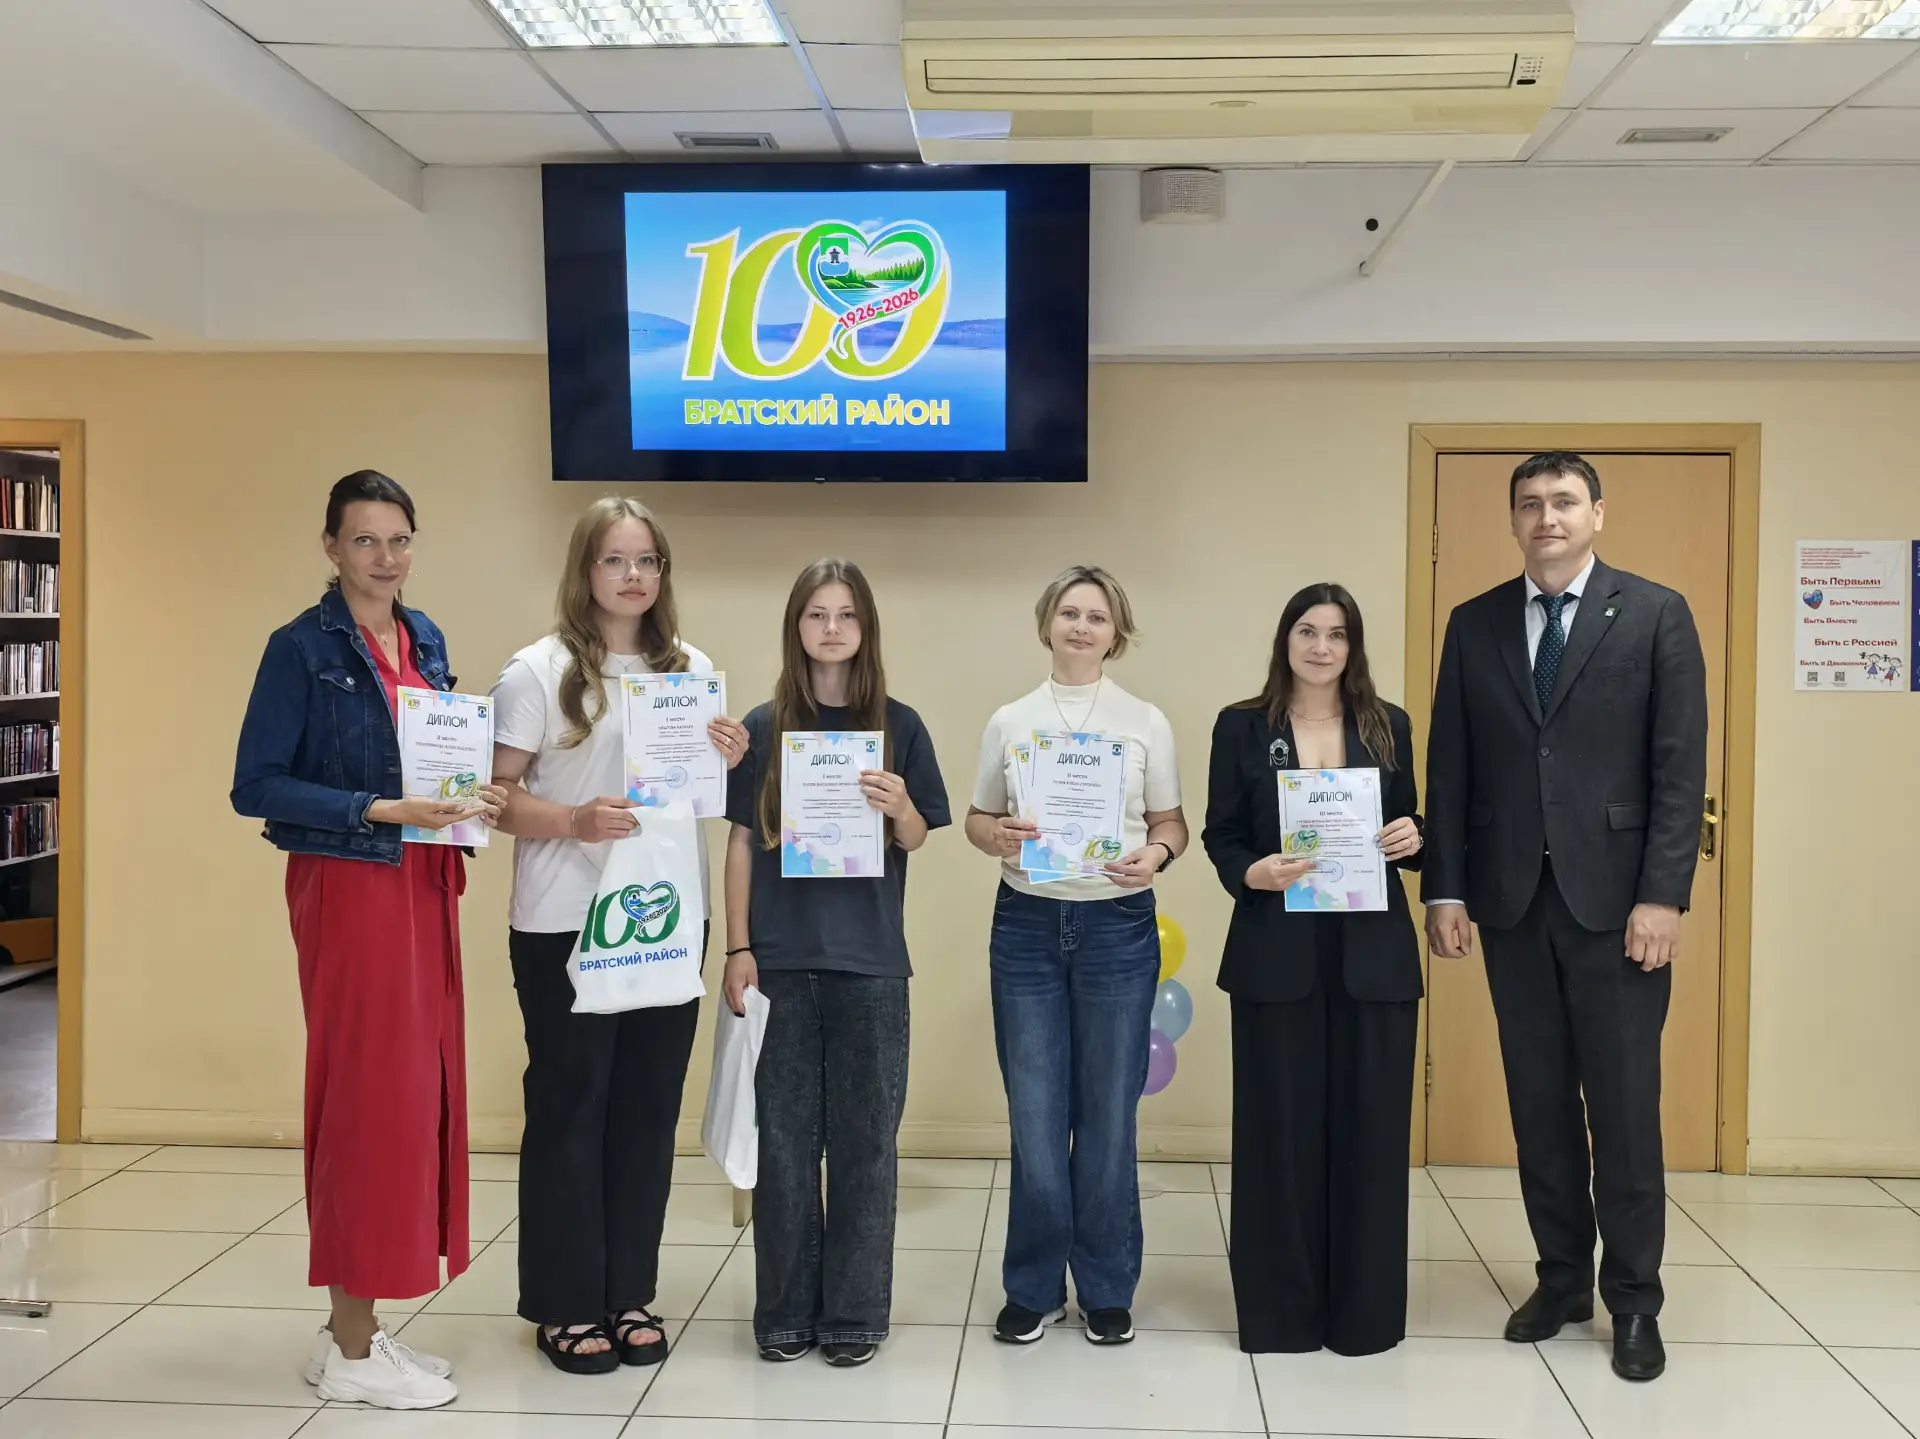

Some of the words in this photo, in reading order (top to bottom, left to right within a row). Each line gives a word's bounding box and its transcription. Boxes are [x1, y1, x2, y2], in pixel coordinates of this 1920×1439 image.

[682, 219, 952, 381] 100
[838, 288, 920, 330] 1926-2026
[684, 393, 838, 425] БРАТСКИЙ
[846, 393, 950, 425] РАЙОН
[1800, 577, 1828, 586] Быть
[1830, 577, 1881, 587] Первыми
[1814, 638, 1841, 646] Быть
[1851, 638, 1898, 646] Россией
[652, 695, 698, 709] ДИПЛОМ
[426, 713, 468, 729] ДИПЛОМ
[810, 754, 855, 767] ДИПЛОМ
[1056, 752, 1101, 766] ДИПЛОМ
[1308, 791, 1353, 803] ДИПЛОМ
[579, 952, 642, 971] БРАТСКИЙ
[645, 947, 688, 963] РАЙОН
